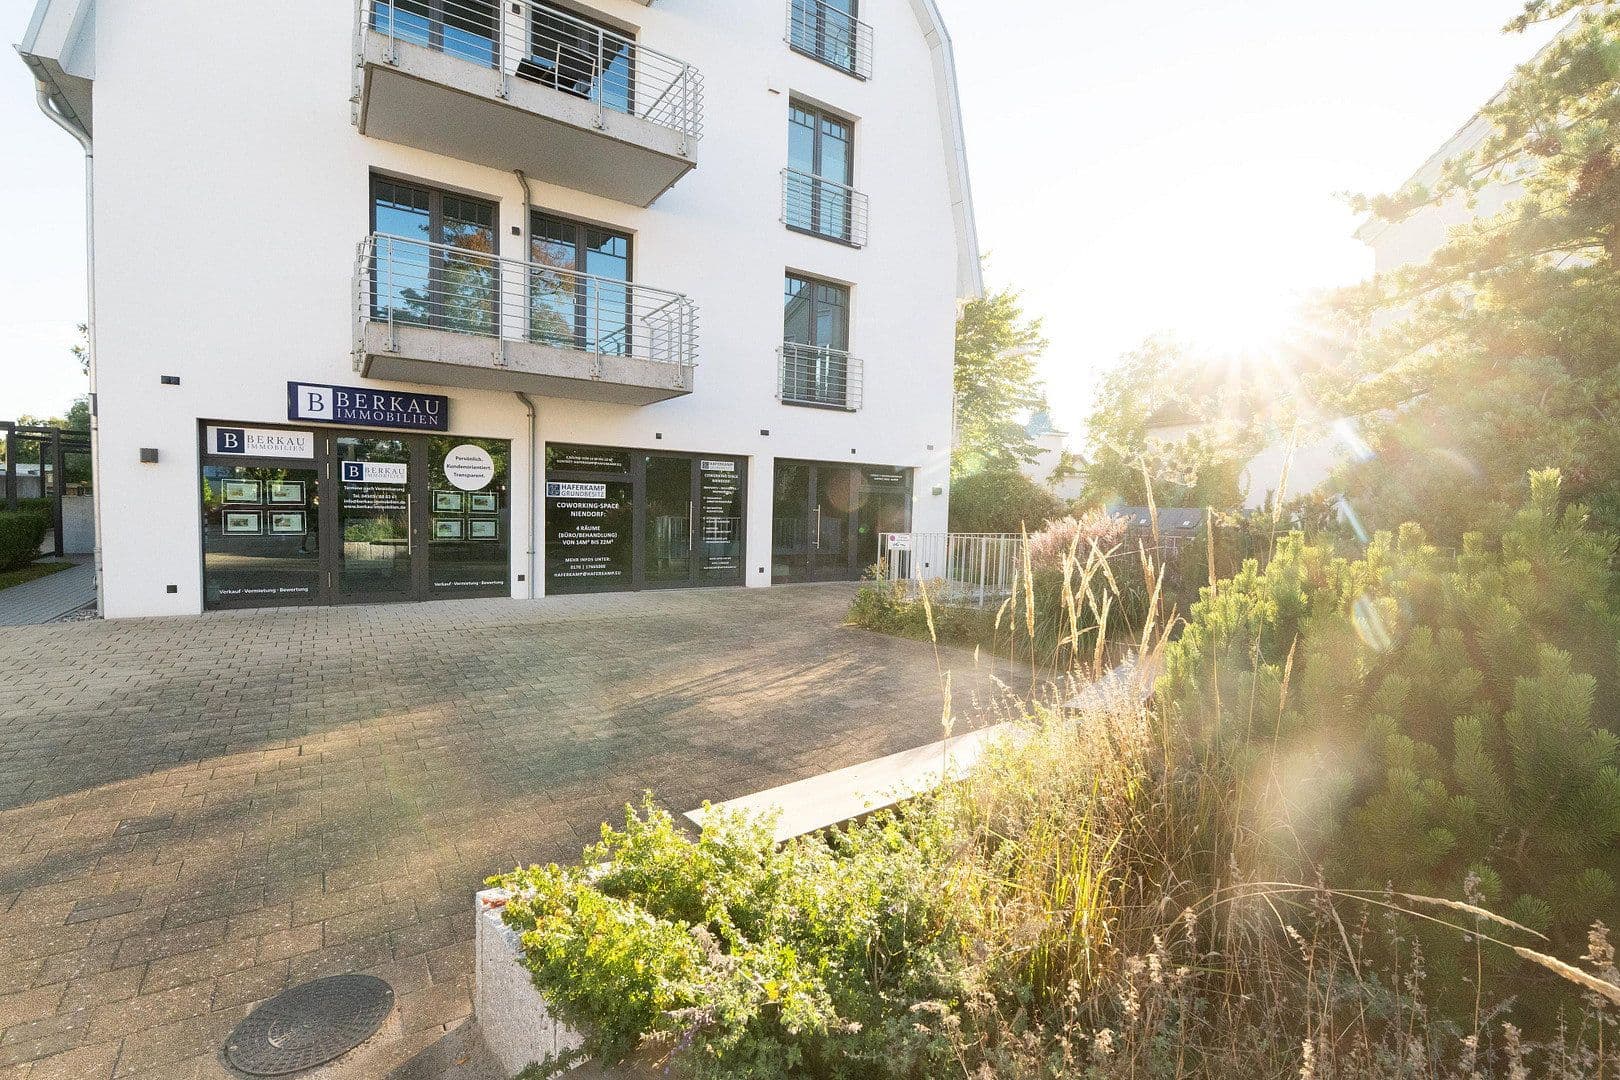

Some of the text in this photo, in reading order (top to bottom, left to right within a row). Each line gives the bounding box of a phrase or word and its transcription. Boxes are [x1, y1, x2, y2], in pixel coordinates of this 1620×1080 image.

[308, 392, 324, 412] B
[336, 391, 440, 415] BERKAU
[337, 408, 438, 425] IMMOBILIEN
[224, 432, 238, 449] B
[247, 434, 305, 446] BERKAU
[247, 443, 305, 452] IMMOBILIEN
[349, 465, 359, 478] B
[366, 467, 405, 475] BERKAU
[561, 484, 605, 492] HAFERKAMP
[561, 490, 605, 498] GRUNDBESITZ
[556, 502, 620, 510] COWORKING-SPACE
